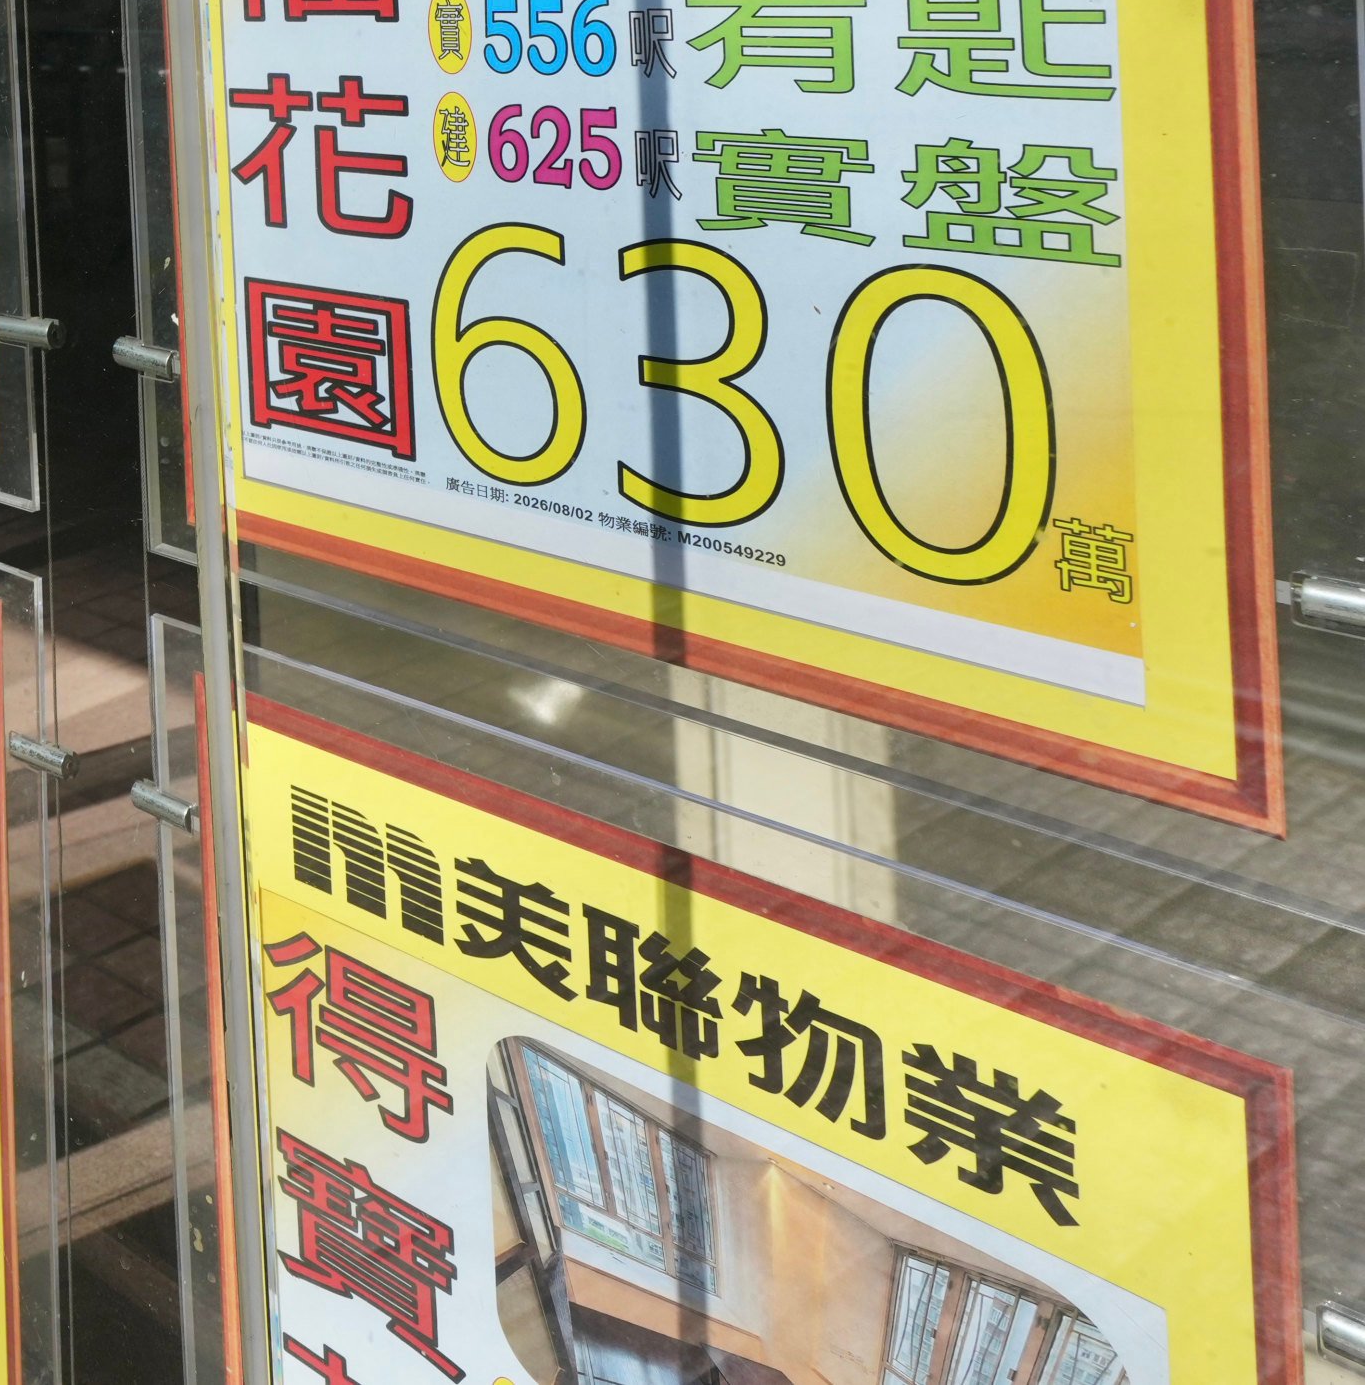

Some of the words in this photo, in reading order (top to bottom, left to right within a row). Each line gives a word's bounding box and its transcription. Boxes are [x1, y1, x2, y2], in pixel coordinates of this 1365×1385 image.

[630, 6, 677, 80] 呎
[487, 103, 623, 193] 625
[634, 127, 683, 201] 呎
[694, 127, 1122, 268] 實盤
[430, 221, 1059, 587] 630
[1051, 517, 1135, 605] 萬
[444, 476, 510, 504] 廣告日期:
[513, 492, 594, 523] 2026/08/02
[597, 511, 672, 542] 物業編號:
[677, 530, 787, 567] M200549229
[455, 856, 1081, 1228] 美聯物業
[262, 931, 467, 1385] 得寶
